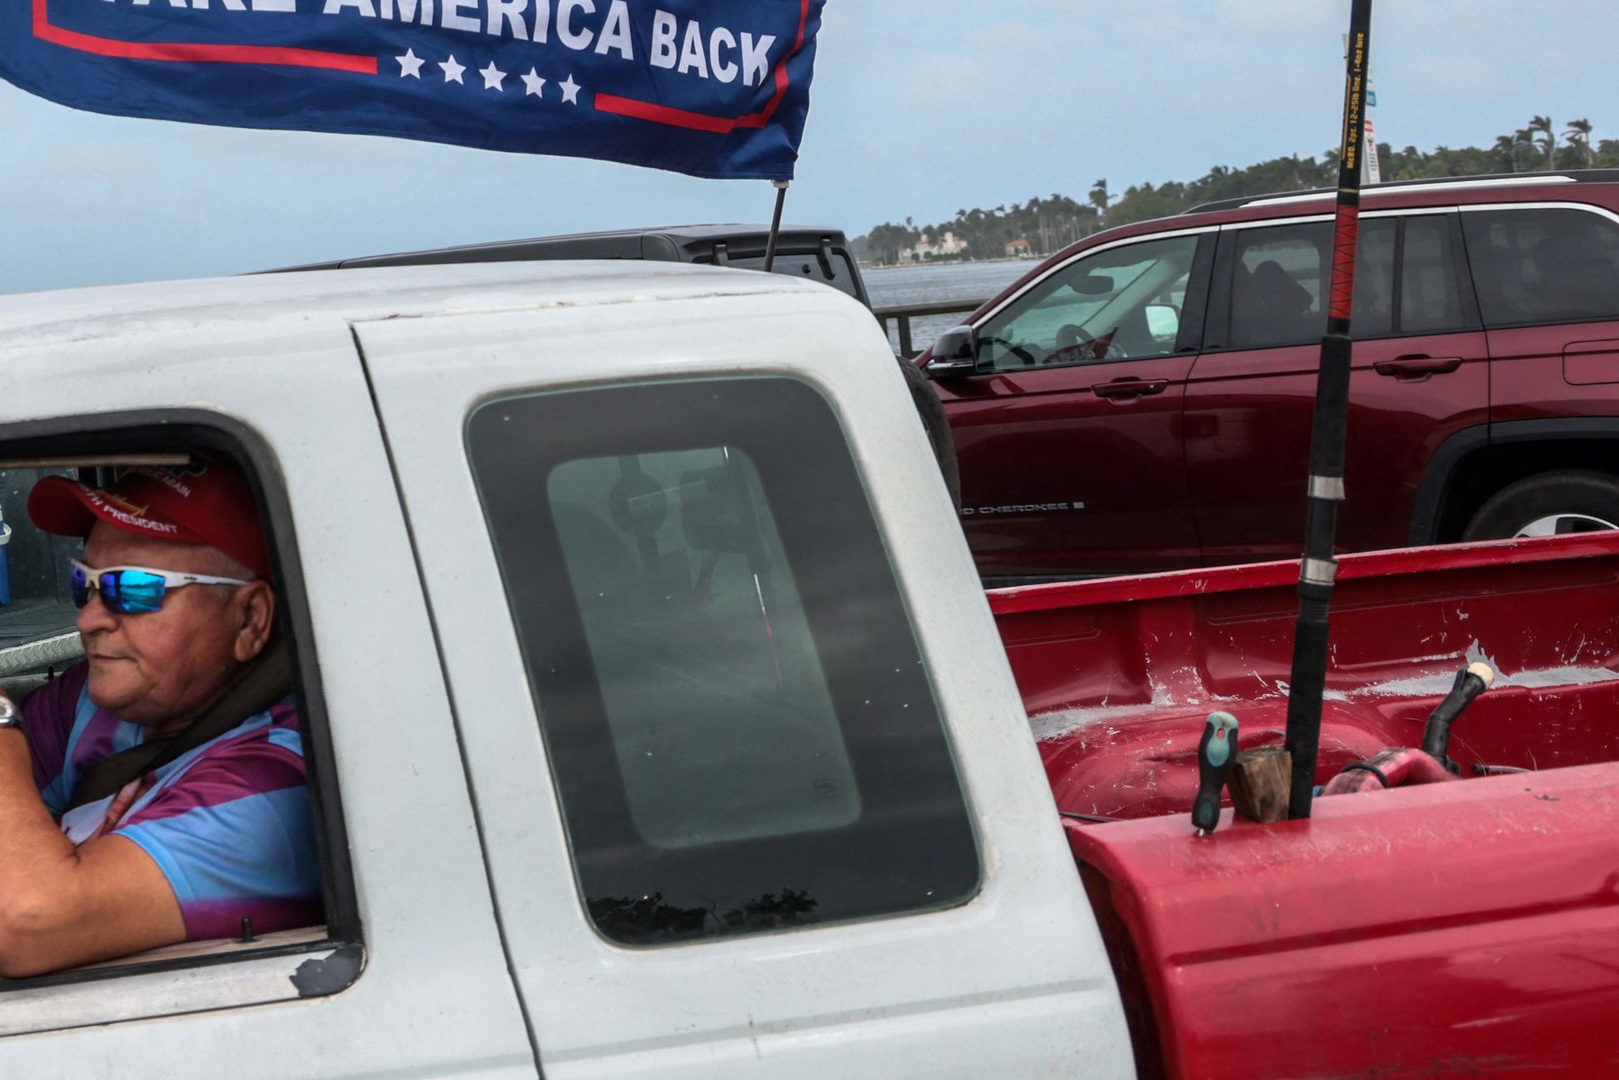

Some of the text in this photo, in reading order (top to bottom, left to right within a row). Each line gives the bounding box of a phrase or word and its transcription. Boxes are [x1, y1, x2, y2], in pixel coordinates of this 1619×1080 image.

[650, 10, 776, 89] BACK
[102, 504, 178, 533] PRESIDENT
[978, 502, 1069, 514] CHEROKEE
